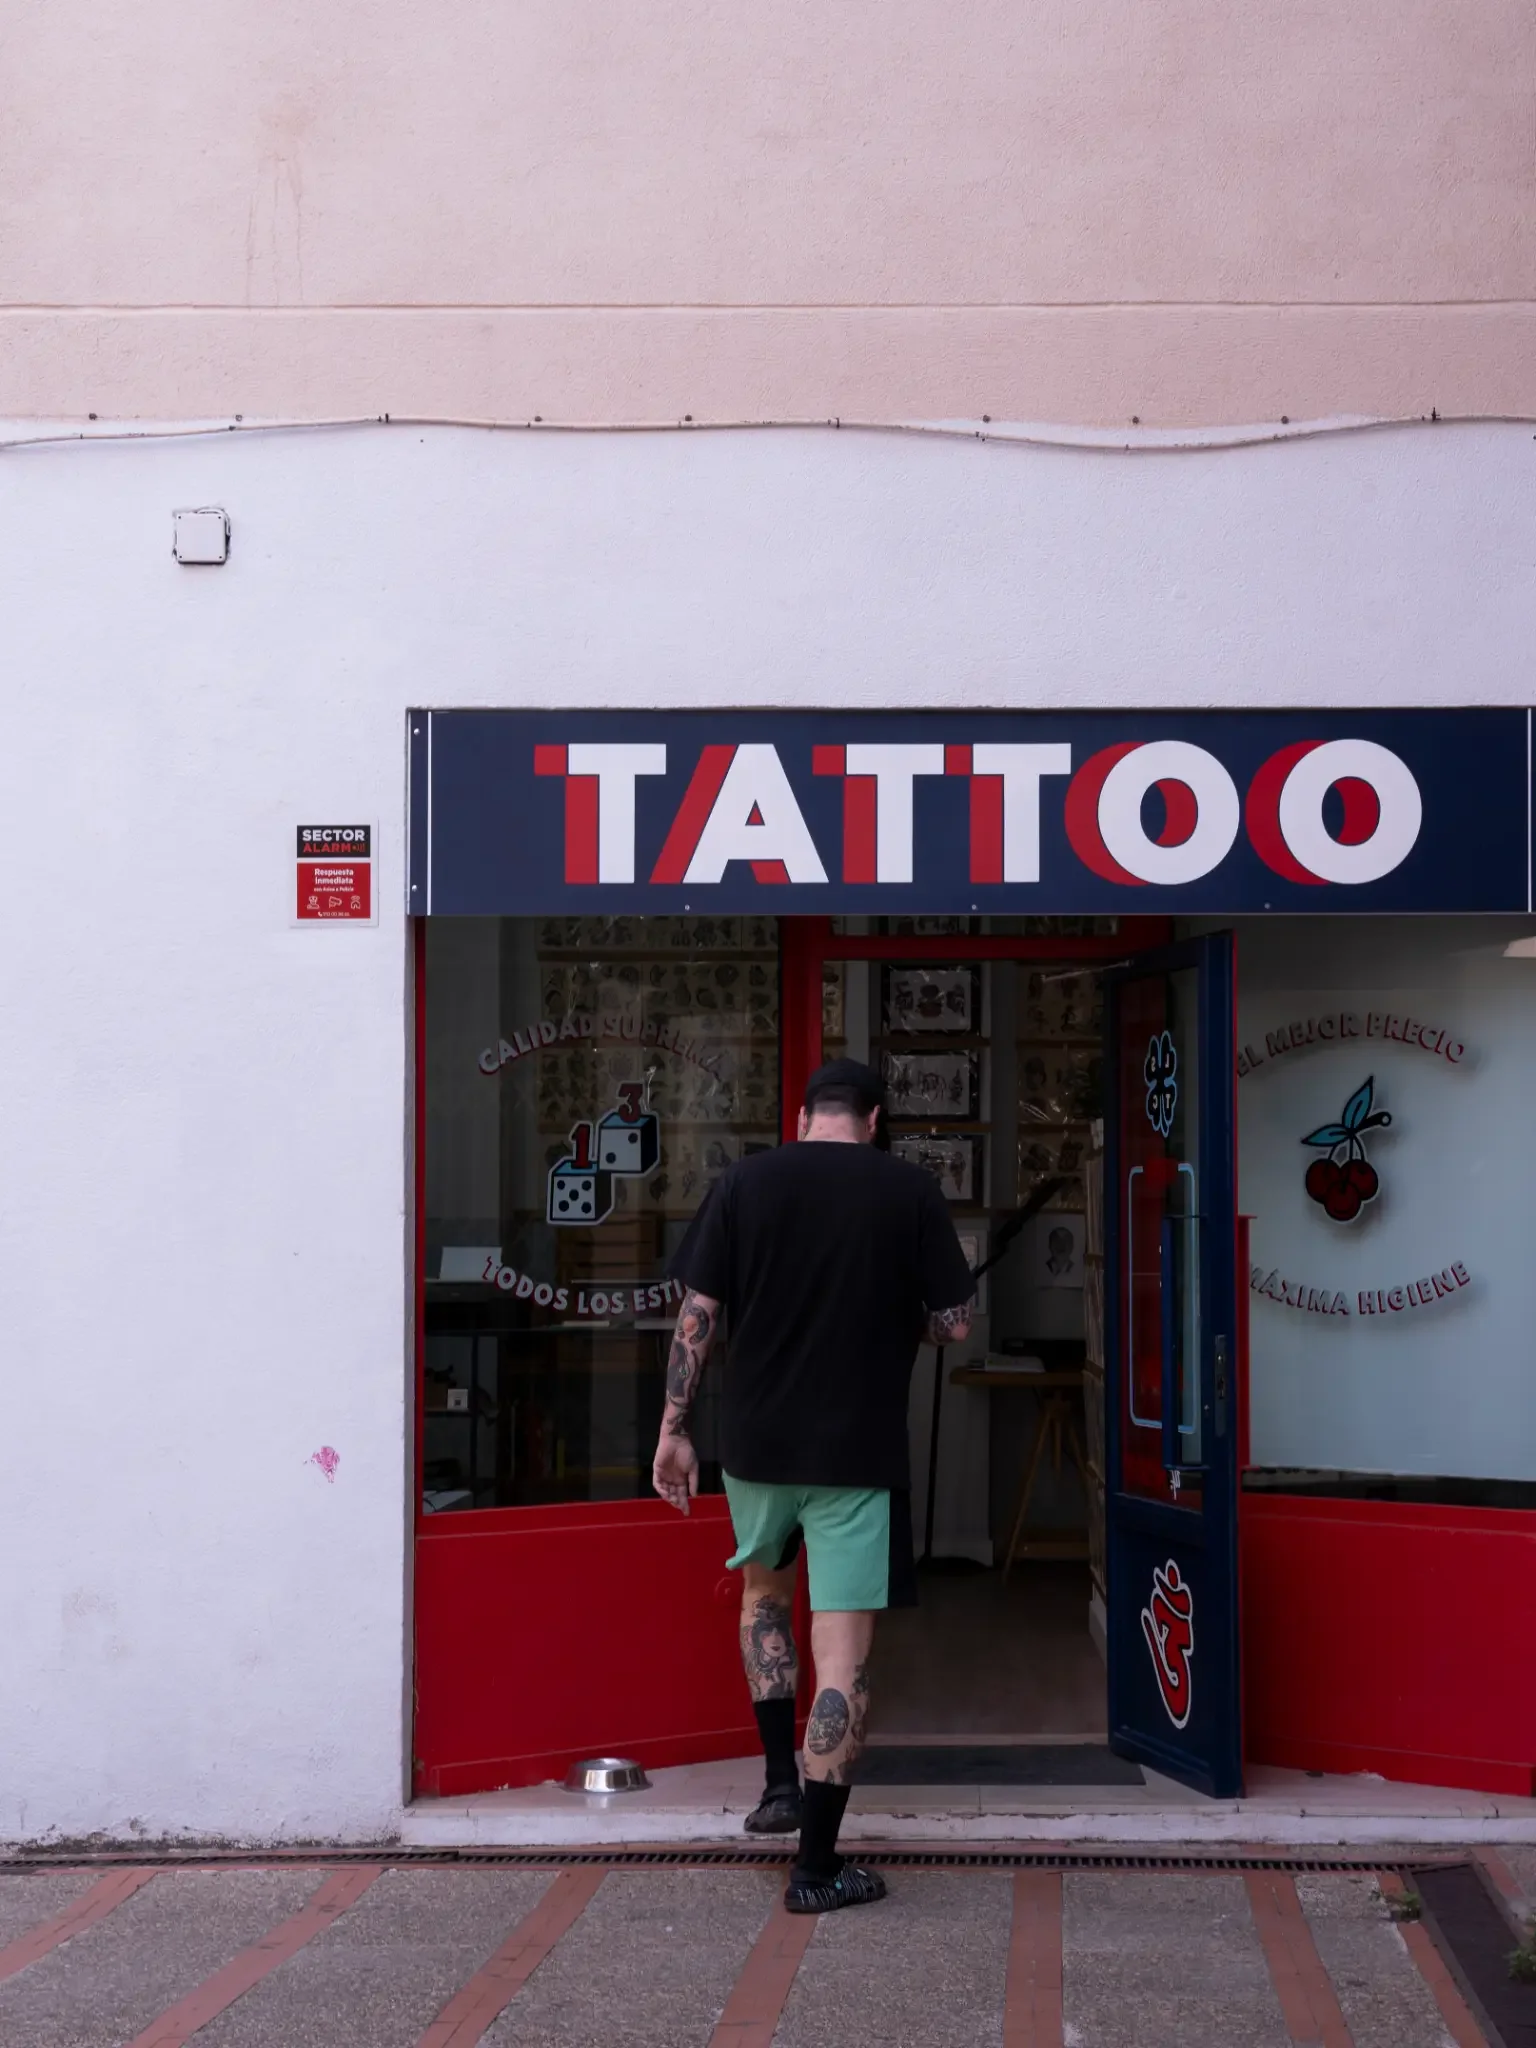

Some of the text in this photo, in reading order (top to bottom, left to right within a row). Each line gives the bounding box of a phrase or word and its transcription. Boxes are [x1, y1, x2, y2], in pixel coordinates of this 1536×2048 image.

[302, 829, 365, 842] SECTOR
[535, 739, 1422, 885] TATTOO
[303, 843, 351, 853] ALARM
[314, 868, 354, 877] Respuesta
[478, 1014, 596, 1076] CALIDAD
[1264, 1012, 1360, 1058] MEJOR
[1365, 1012, 1466, 1064] PRECIO
[482, 1256, 686, 1316] TODOS LOS ESTI
[1356, 1260, 1472, 1315] HIGIENE
